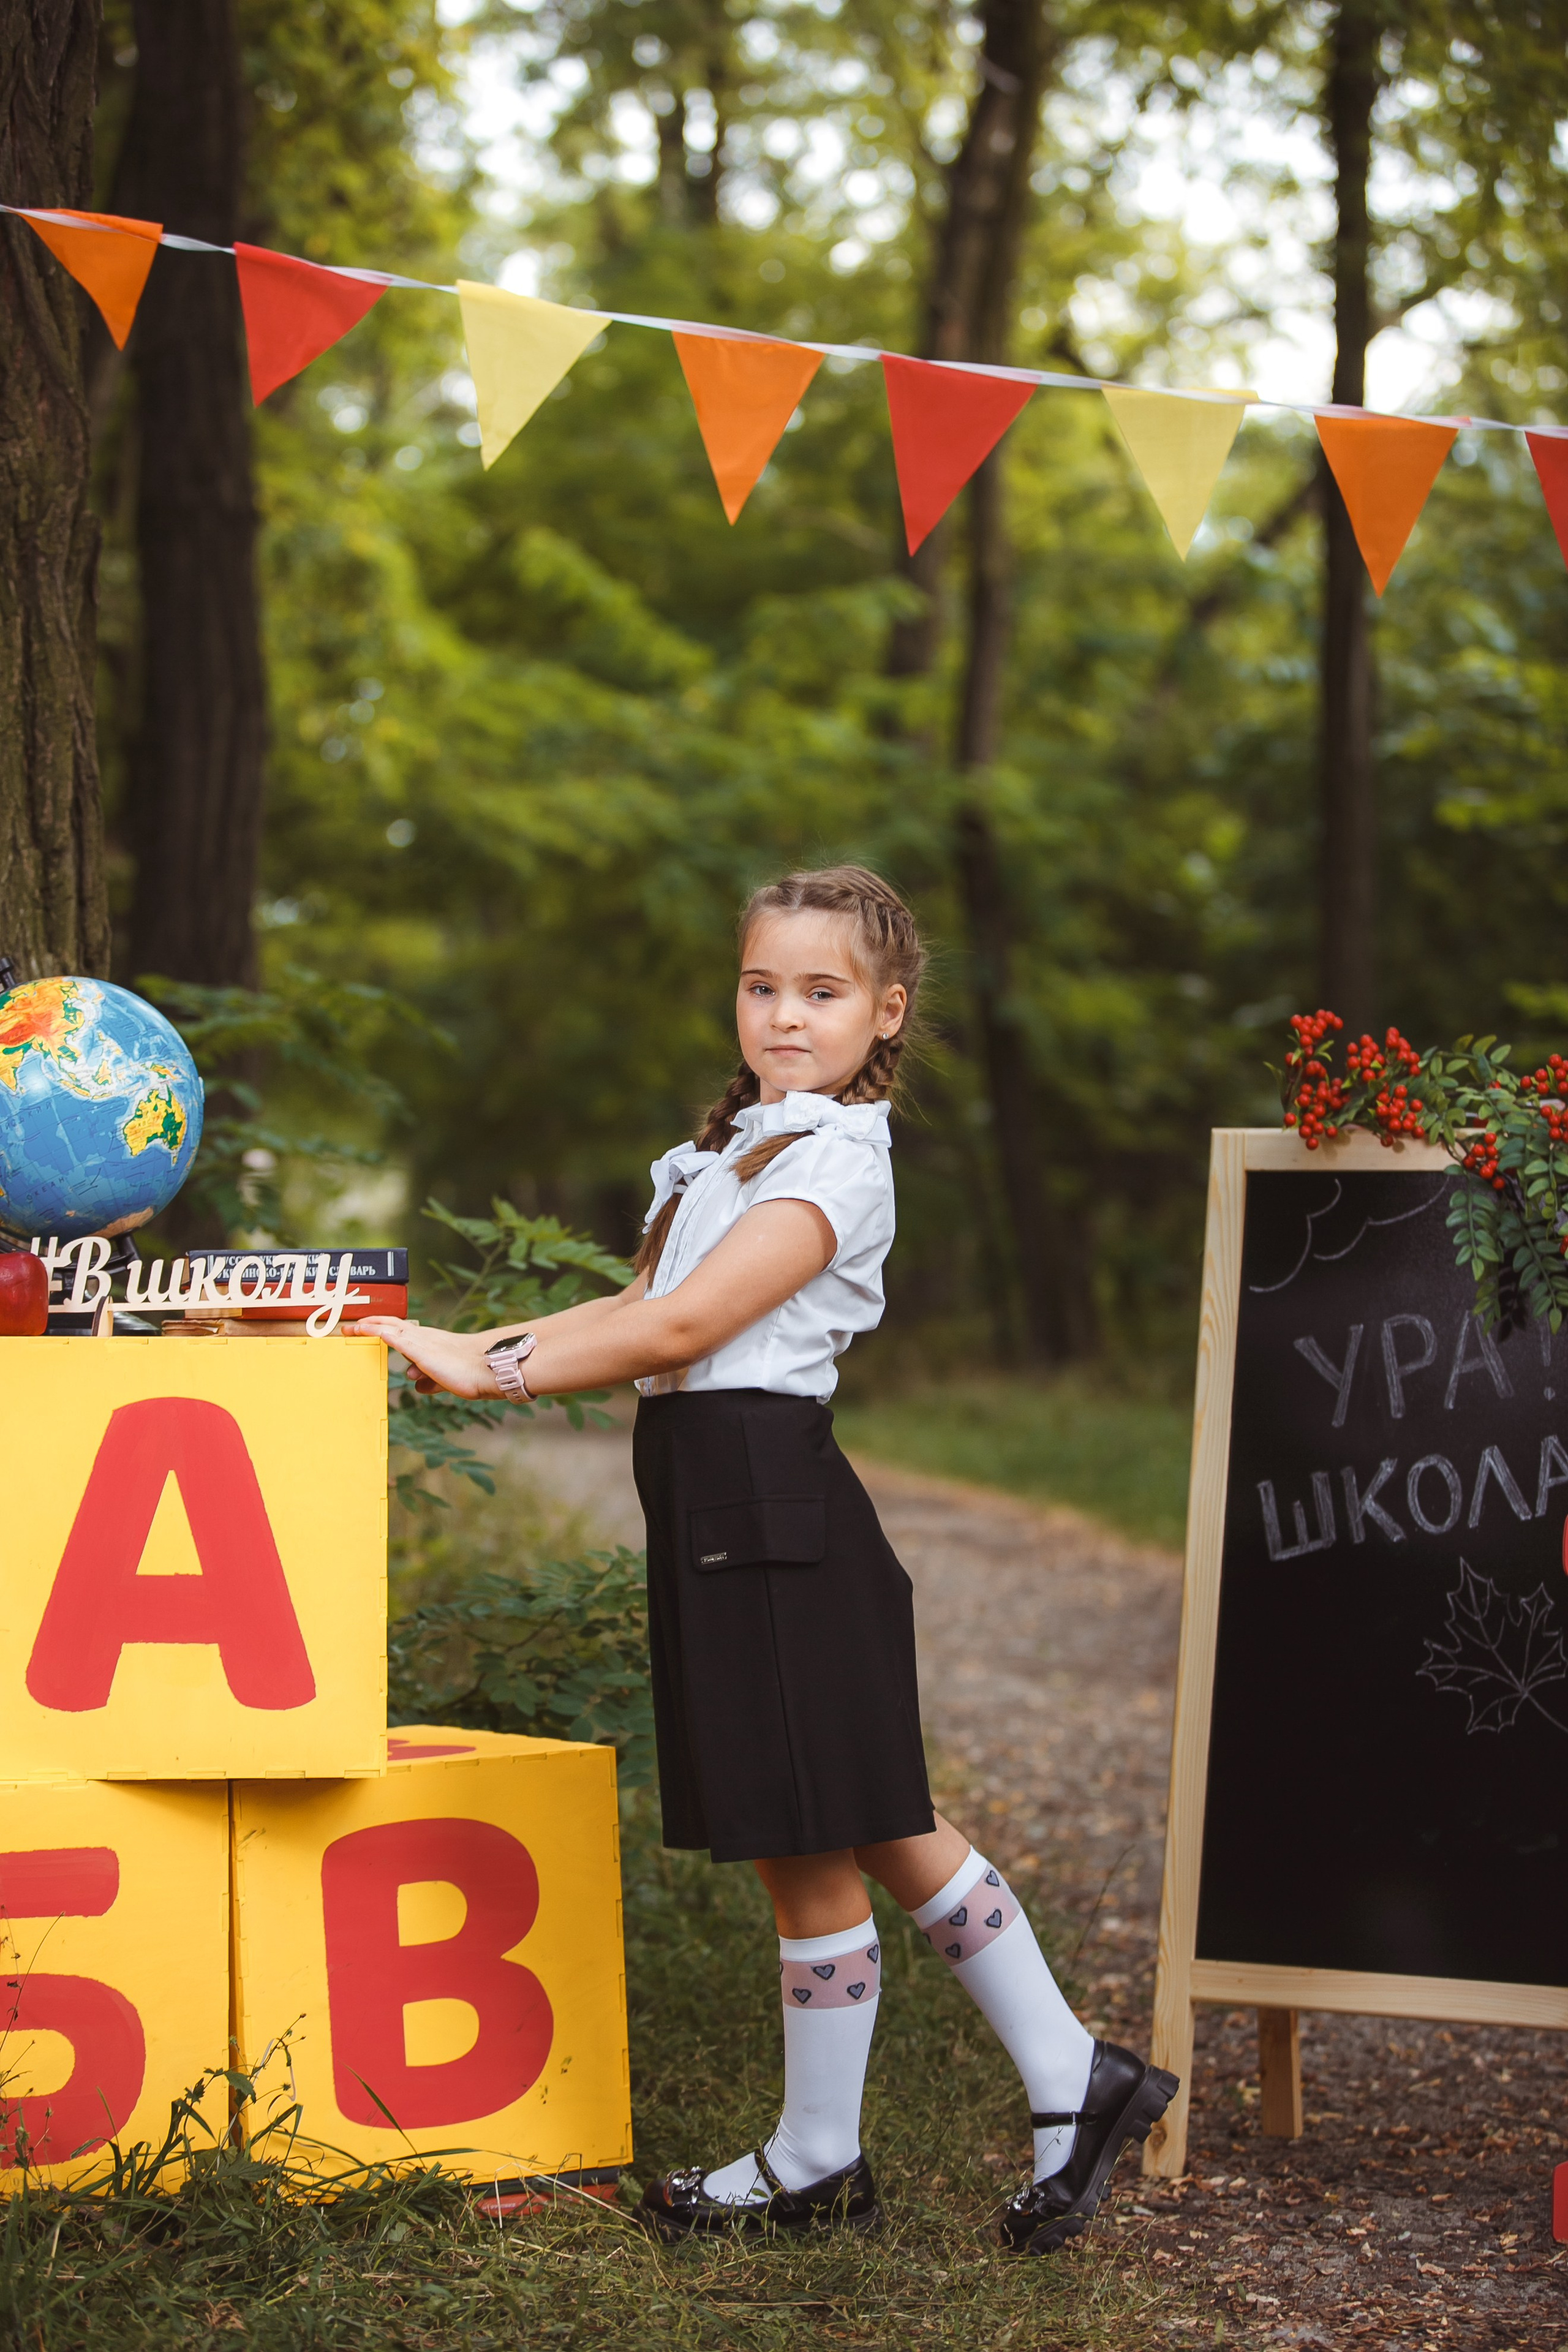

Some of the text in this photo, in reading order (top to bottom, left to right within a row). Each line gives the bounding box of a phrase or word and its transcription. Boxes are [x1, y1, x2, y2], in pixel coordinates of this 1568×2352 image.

[125, 1253, 360, 1338] школу
[328, 1265, 376, 1276] СВАРЬ
[1293, 1310, 1556, 1428] УРА!
[26, 1396, 316, 1713] А
[1257, 1435, 1568, 1561] ШКОЛА
[321, 1817, 554, 2128] В
